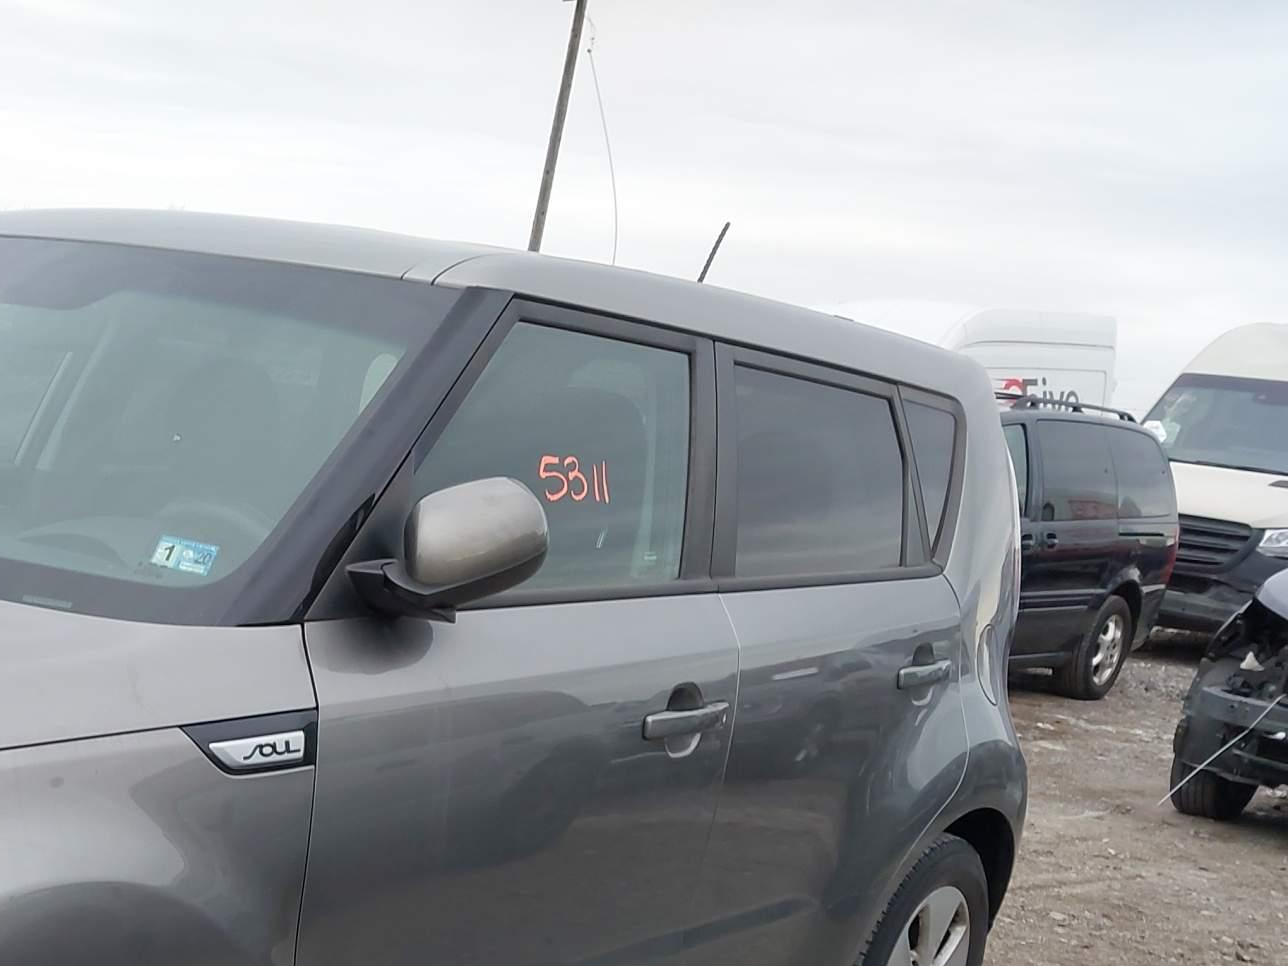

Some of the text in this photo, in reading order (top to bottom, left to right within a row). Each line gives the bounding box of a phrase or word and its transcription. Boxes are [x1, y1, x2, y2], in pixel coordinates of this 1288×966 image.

[539, 455, 610, 504] 5311
[164, 544, 176, 561] 1
[243, 740, 301, 760] SOUL
